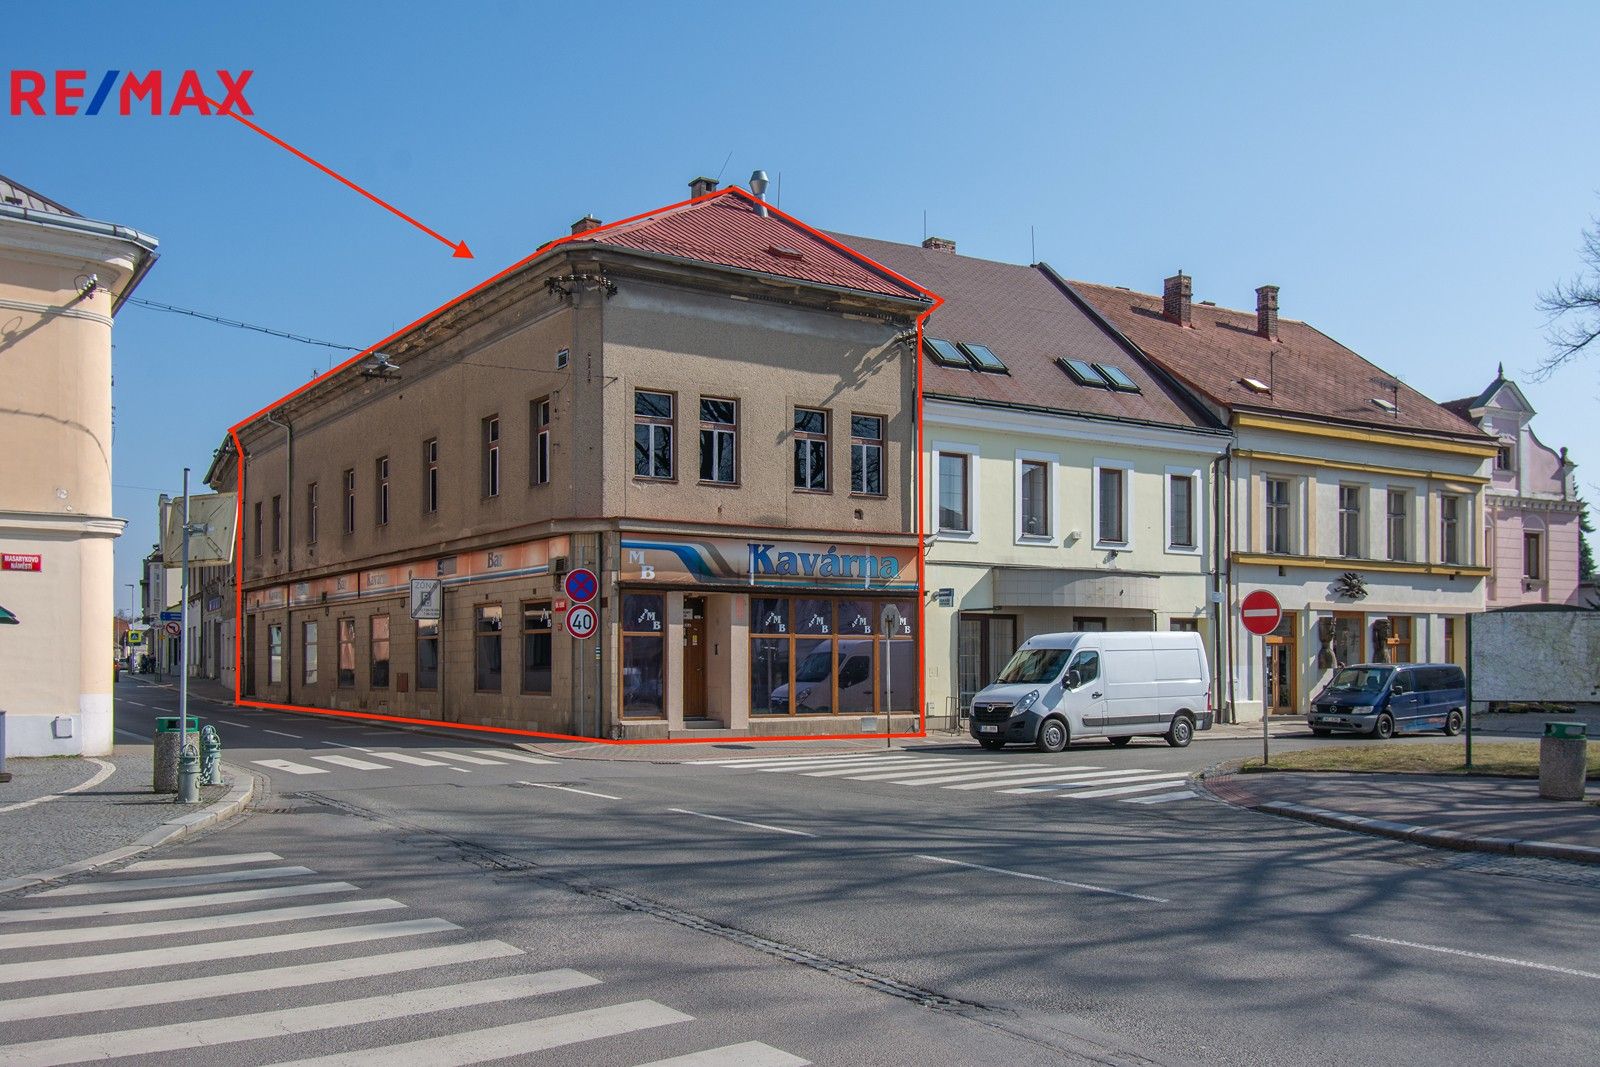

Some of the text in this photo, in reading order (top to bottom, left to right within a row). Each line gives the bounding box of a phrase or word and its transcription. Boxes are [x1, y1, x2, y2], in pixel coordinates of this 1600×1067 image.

[4, 555, 39, 563] MASARYKOVO
[747, 543, 900, 578] Kavárna
[572, 614, 592, 630] 40
